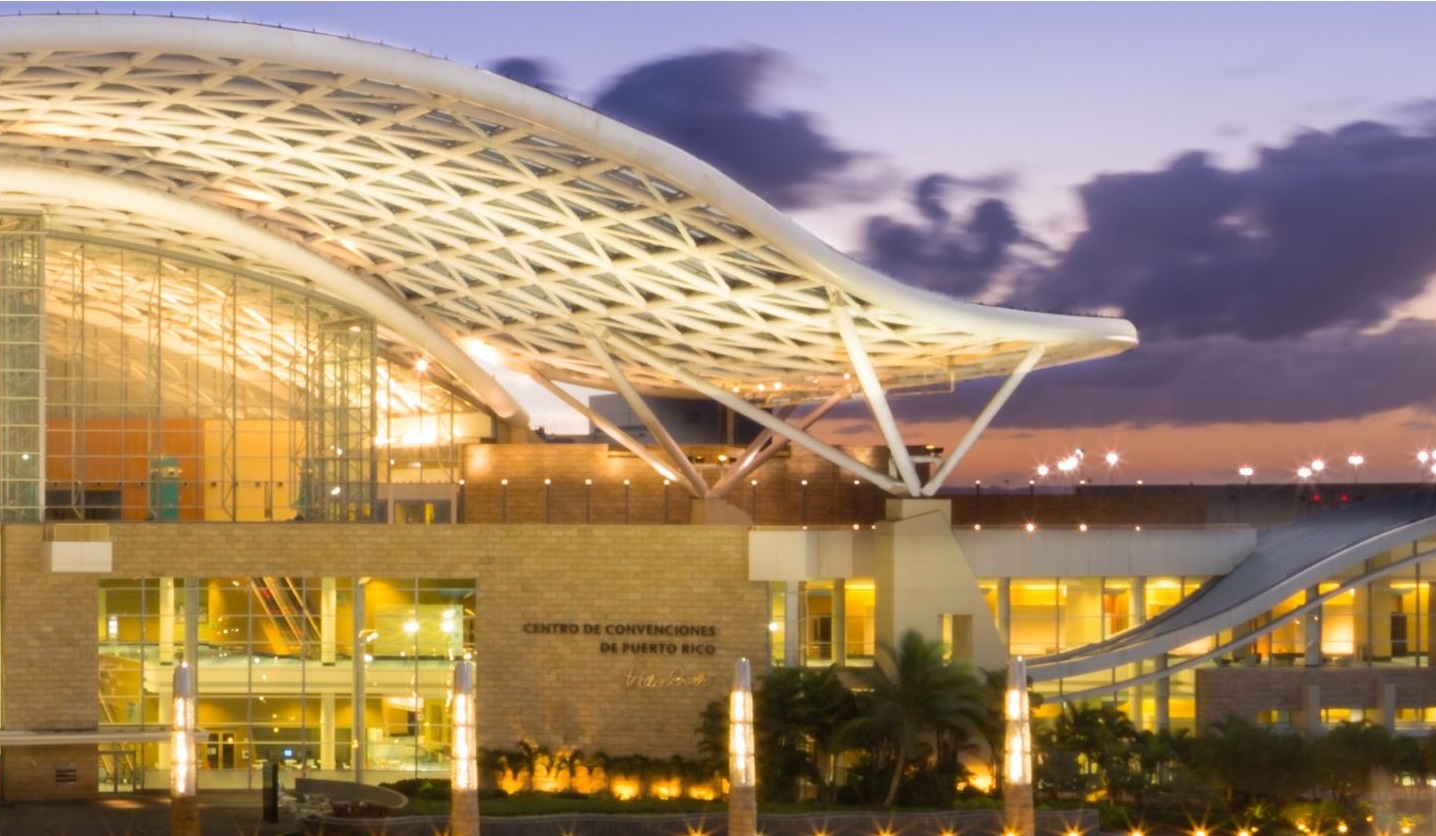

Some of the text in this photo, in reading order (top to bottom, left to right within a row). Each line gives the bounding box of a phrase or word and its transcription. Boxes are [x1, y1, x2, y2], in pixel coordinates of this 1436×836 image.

[523, 622, 716, 637] CENTRO DE CONVENCIONES
[600, 642, 716, 656] DE PUERTO RICO
